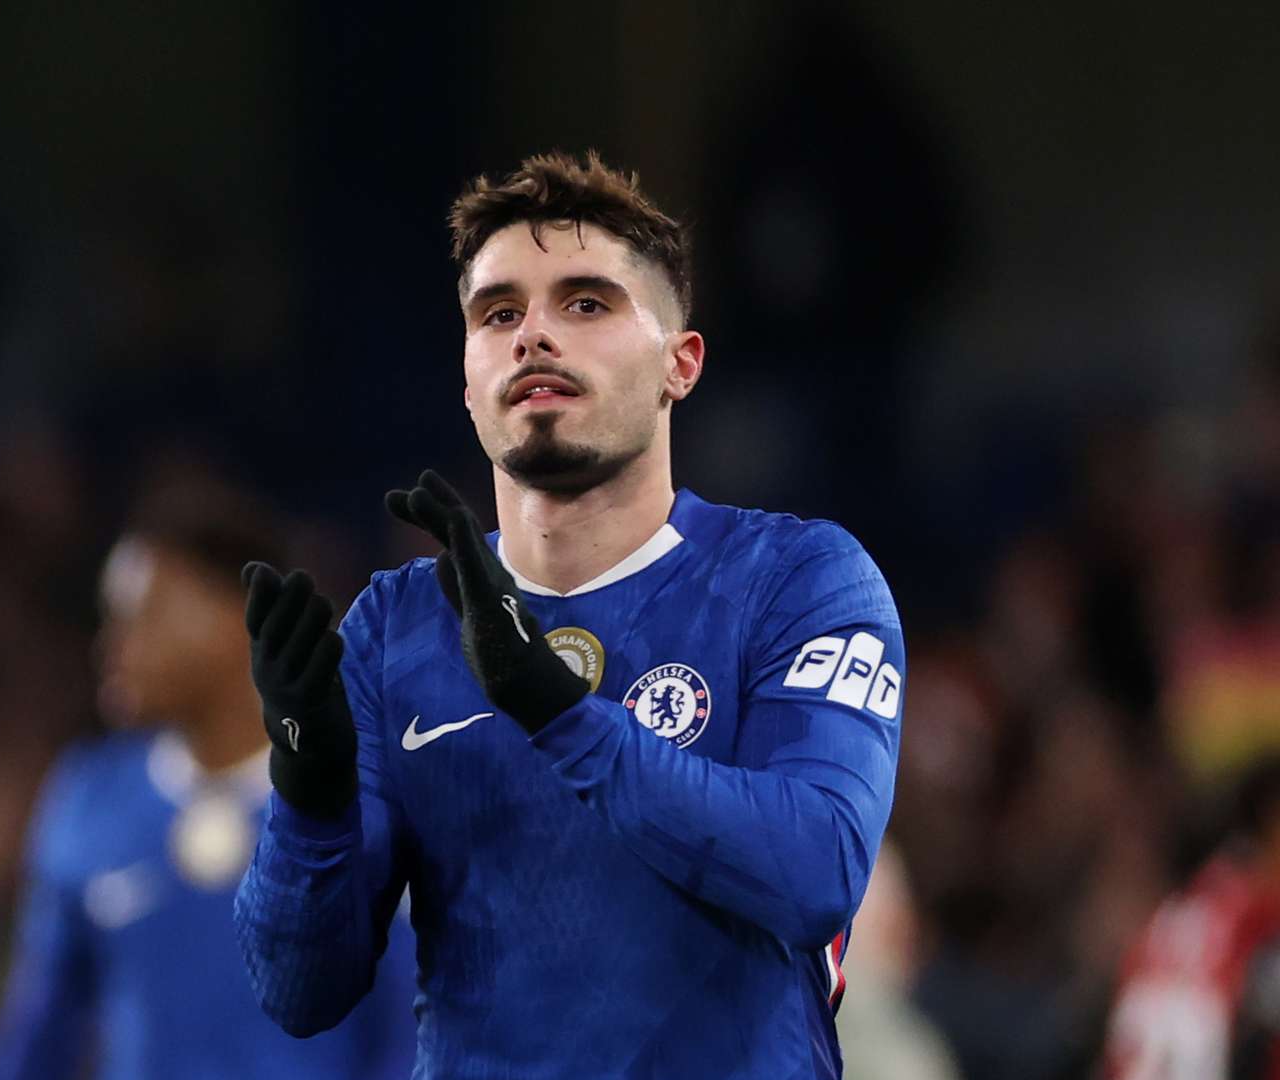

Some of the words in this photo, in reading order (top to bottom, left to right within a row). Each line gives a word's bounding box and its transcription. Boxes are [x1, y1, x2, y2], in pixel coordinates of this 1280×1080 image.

[638, 667, 693, 691] CHELSEA
[795, 649, 897, 703] FPT
[676, 727, 696, 744] CLUB
